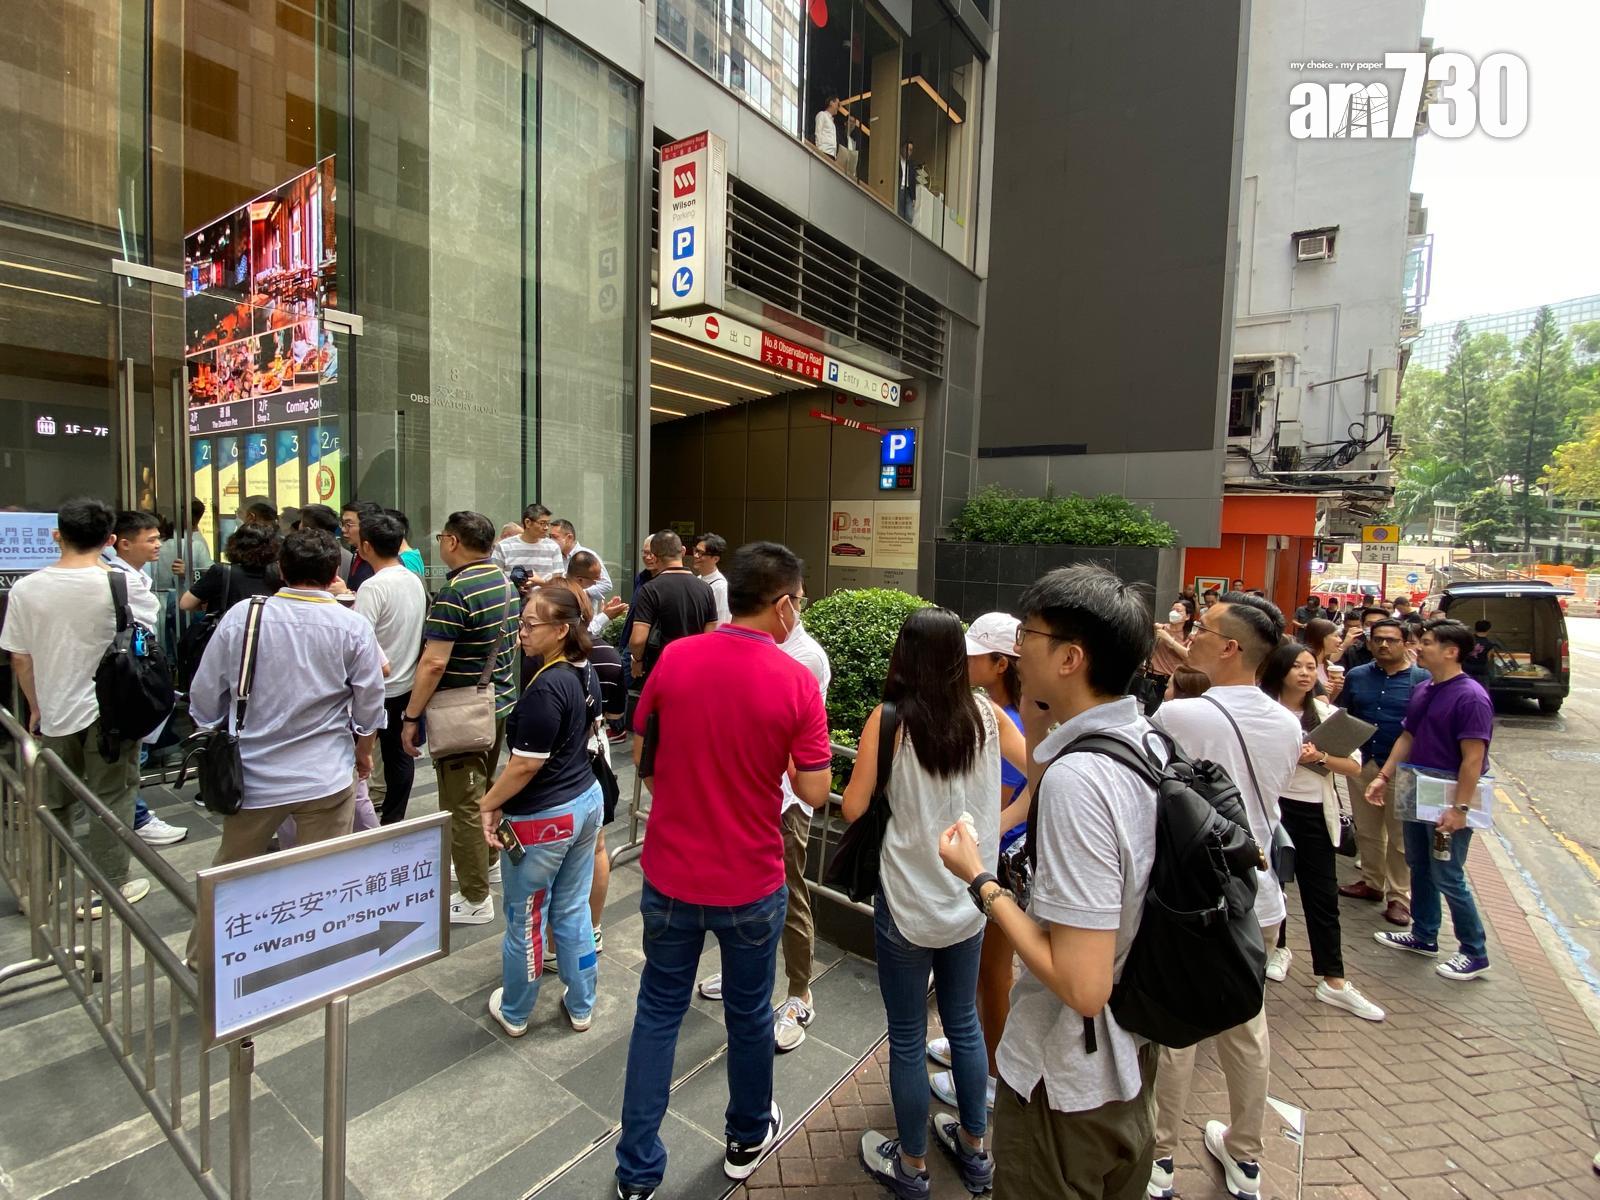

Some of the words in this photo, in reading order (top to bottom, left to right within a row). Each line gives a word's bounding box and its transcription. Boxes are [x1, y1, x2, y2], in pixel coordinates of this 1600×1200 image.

[672, 199, 696, 211] Wilson
[672, 208, 696, 222] Parking
[678, 232, 692, 256] P
[729, 329, 752, 348] 出口
[764, 335, 778, 350] No.8
[778, 341, 809, 362] Observatory
[809, 352, 822, 366] Road
[843, 371, 860, 387] Entry
[864, 380, 878, 392] 入口
[258, 399, 269, 414] 2/F
[286, 399, 309, 414] Coming
[65, 424, 81, 434] 1F
[93, 426, 109, 437] 7F
[259, 438, 268, 455] 5
[290, 435, 299, 453] 3
[321, 431, 340, 449] 2/F
[889, 434, 907, 459] P
[231, 441, 239, 458] 6
[0, 527, 50, 537] 門已關
[0, 546, 20, 554] OR
[1365, 544, 1378, 552] 24
[1380, 544, 1395, 552] hrs
[1369, 552, 1391, 562] 全日
[224, 859, 434, 940] 往“宏安”示範單位
[221, 951, 248, 967] To
[253, 927, 317, 954] “Wang
[405, 887, 436, 908] Flat
